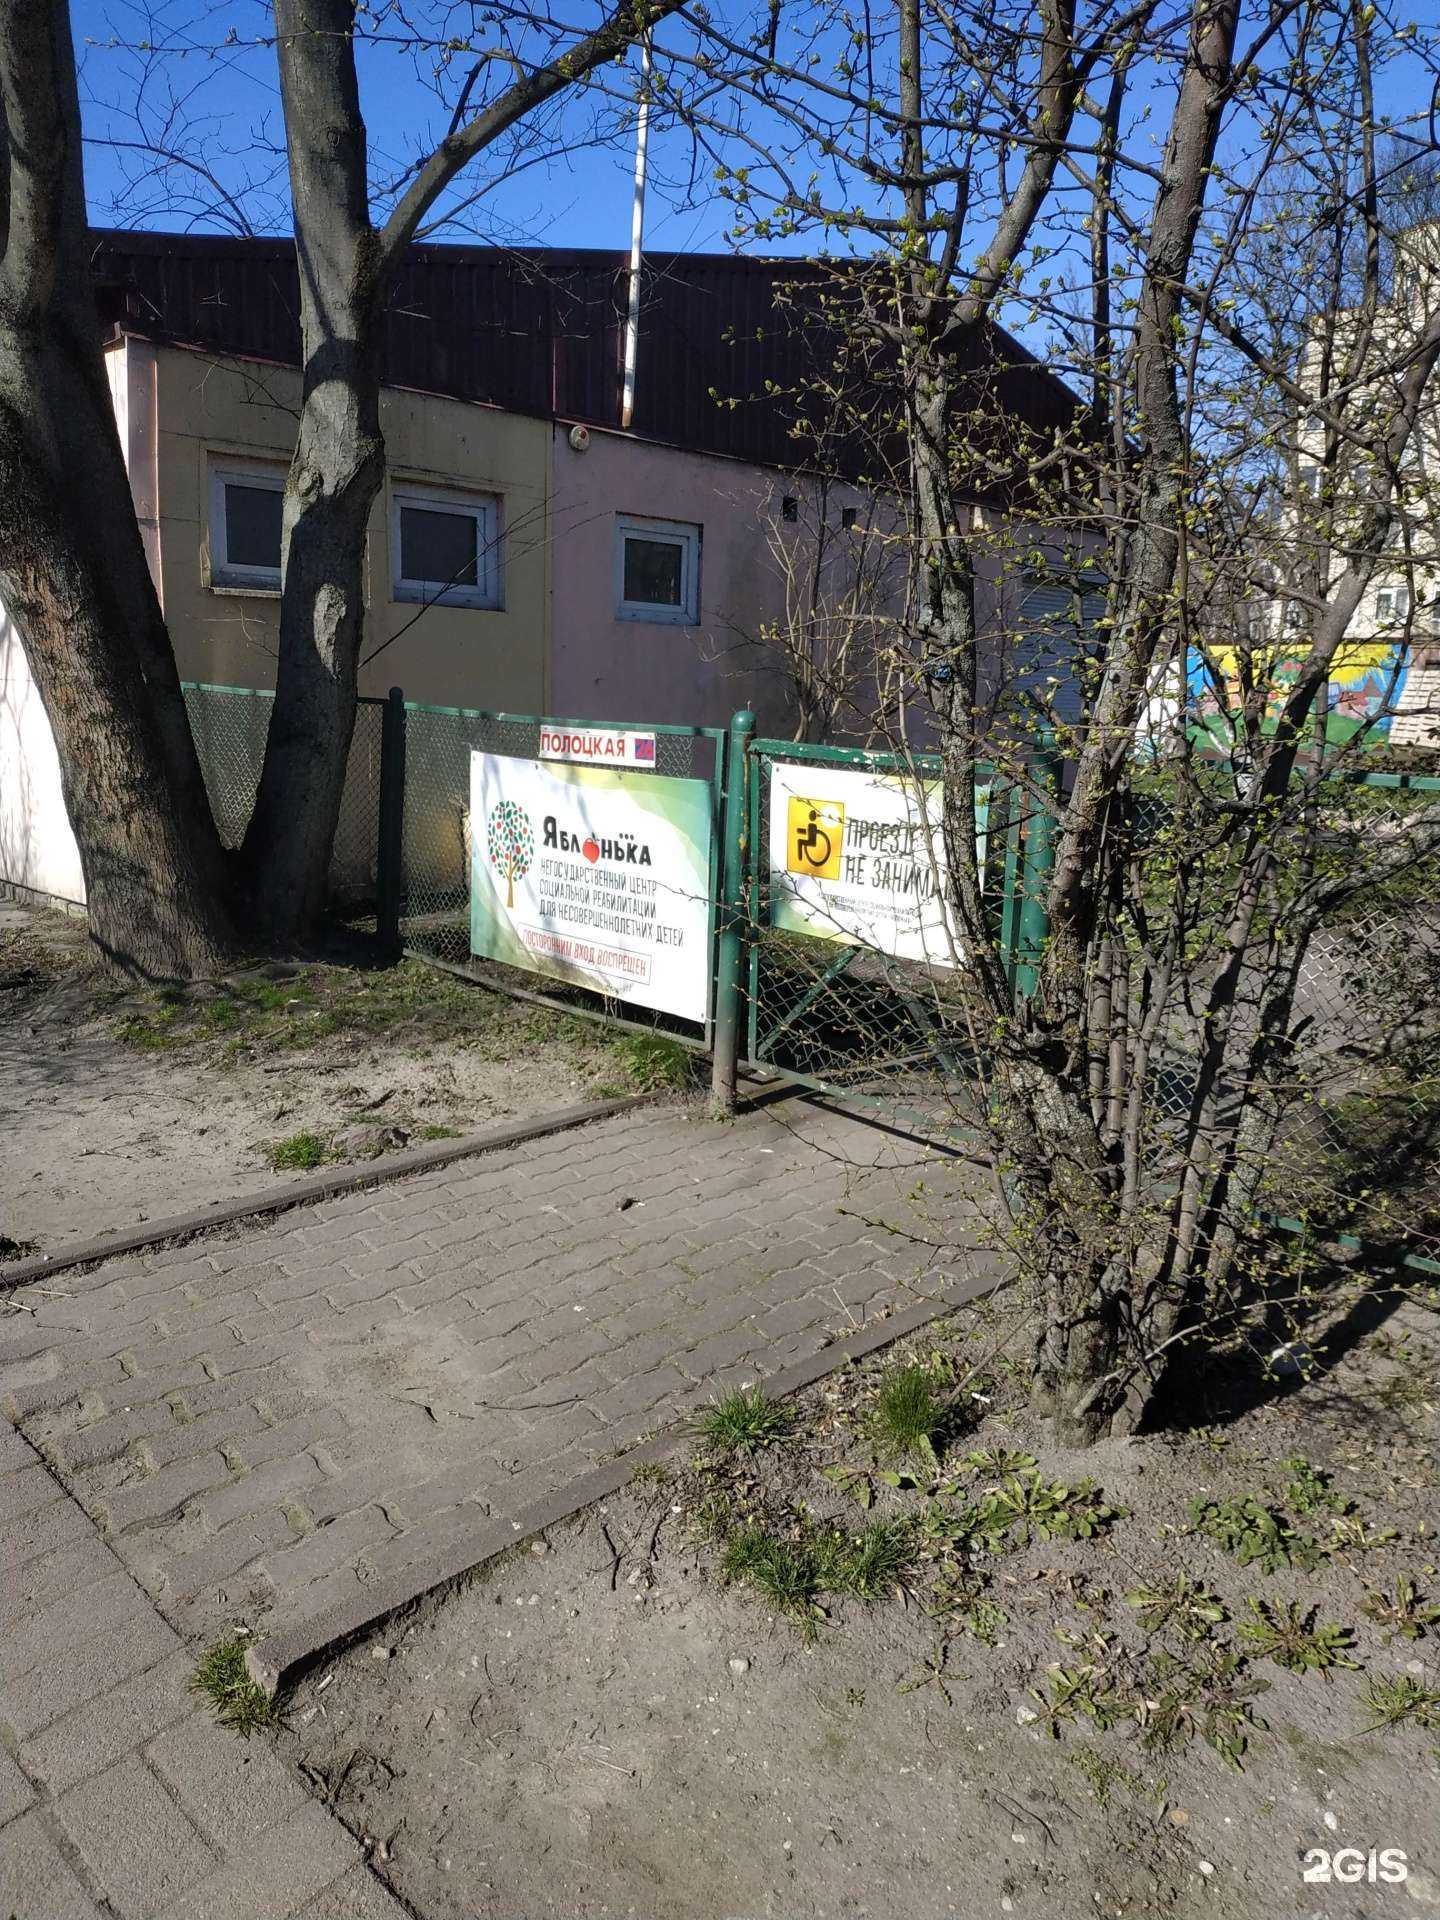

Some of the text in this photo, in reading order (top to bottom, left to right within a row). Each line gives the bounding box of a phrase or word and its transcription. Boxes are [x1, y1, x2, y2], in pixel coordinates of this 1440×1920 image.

[541, 733, 625, 757] ПОЛОЦКАЯ
[541, 858, 656, 896] НЕГОСУДАРСТВЕННЫЙ ЦЕНТР
[845, 855, 865, 885] НЕ
[540, 879, 656, 919] СОЦИАЛЬНОЙ РЕАБИЛИТАЦИИ
[539, 899, 683, 947] ДЛЯ НЕСОВЕРШЕННОЛЕТНИХ ДЕТЕЙ
[574, 943, 595, 965] ВХОД
[597, 949, 646, 976] ВОСПРЕЩЕН
